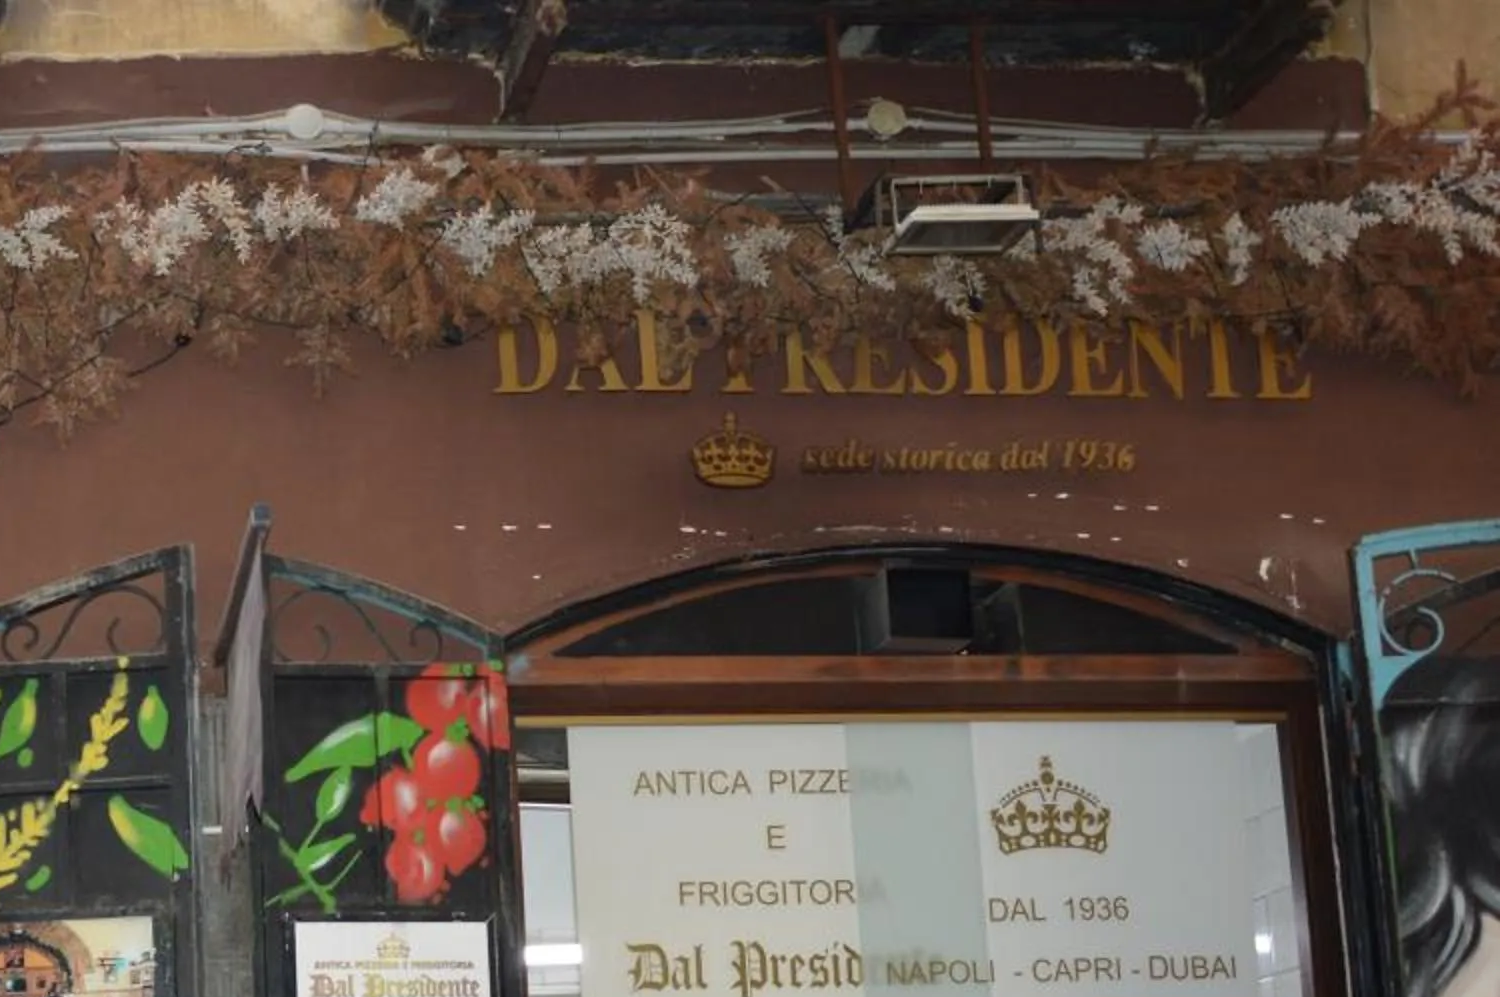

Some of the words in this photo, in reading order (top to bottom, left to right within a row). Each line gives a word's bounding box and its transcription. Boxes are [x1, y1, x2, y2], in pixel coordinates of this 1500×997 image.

[720, 314, 1312, 399] RESIDENTE
[804, 437, 874, 470] sede
[883, 440, 991, 472] storica
[1001, 439, 1049, 472] dal
[1062, 436, 1137, 472] 1936
[633, 768, 752, 798] ANTICA
[768, 766, 905, 797] PIZZE
[766, 825, 787, 851] E
[678, 879, 880, 908] FRIGGITOR
[987, 896, 1046, 923] DAL
[1063, 895, 1129, 922] 1936
[627, 942, 708, 993] Dal
[886, 957, 996, 987] NAPOLI
[1031, 955, 1123, 985] CAPRI
[1146, 952, 1238, 983] DUBAI
